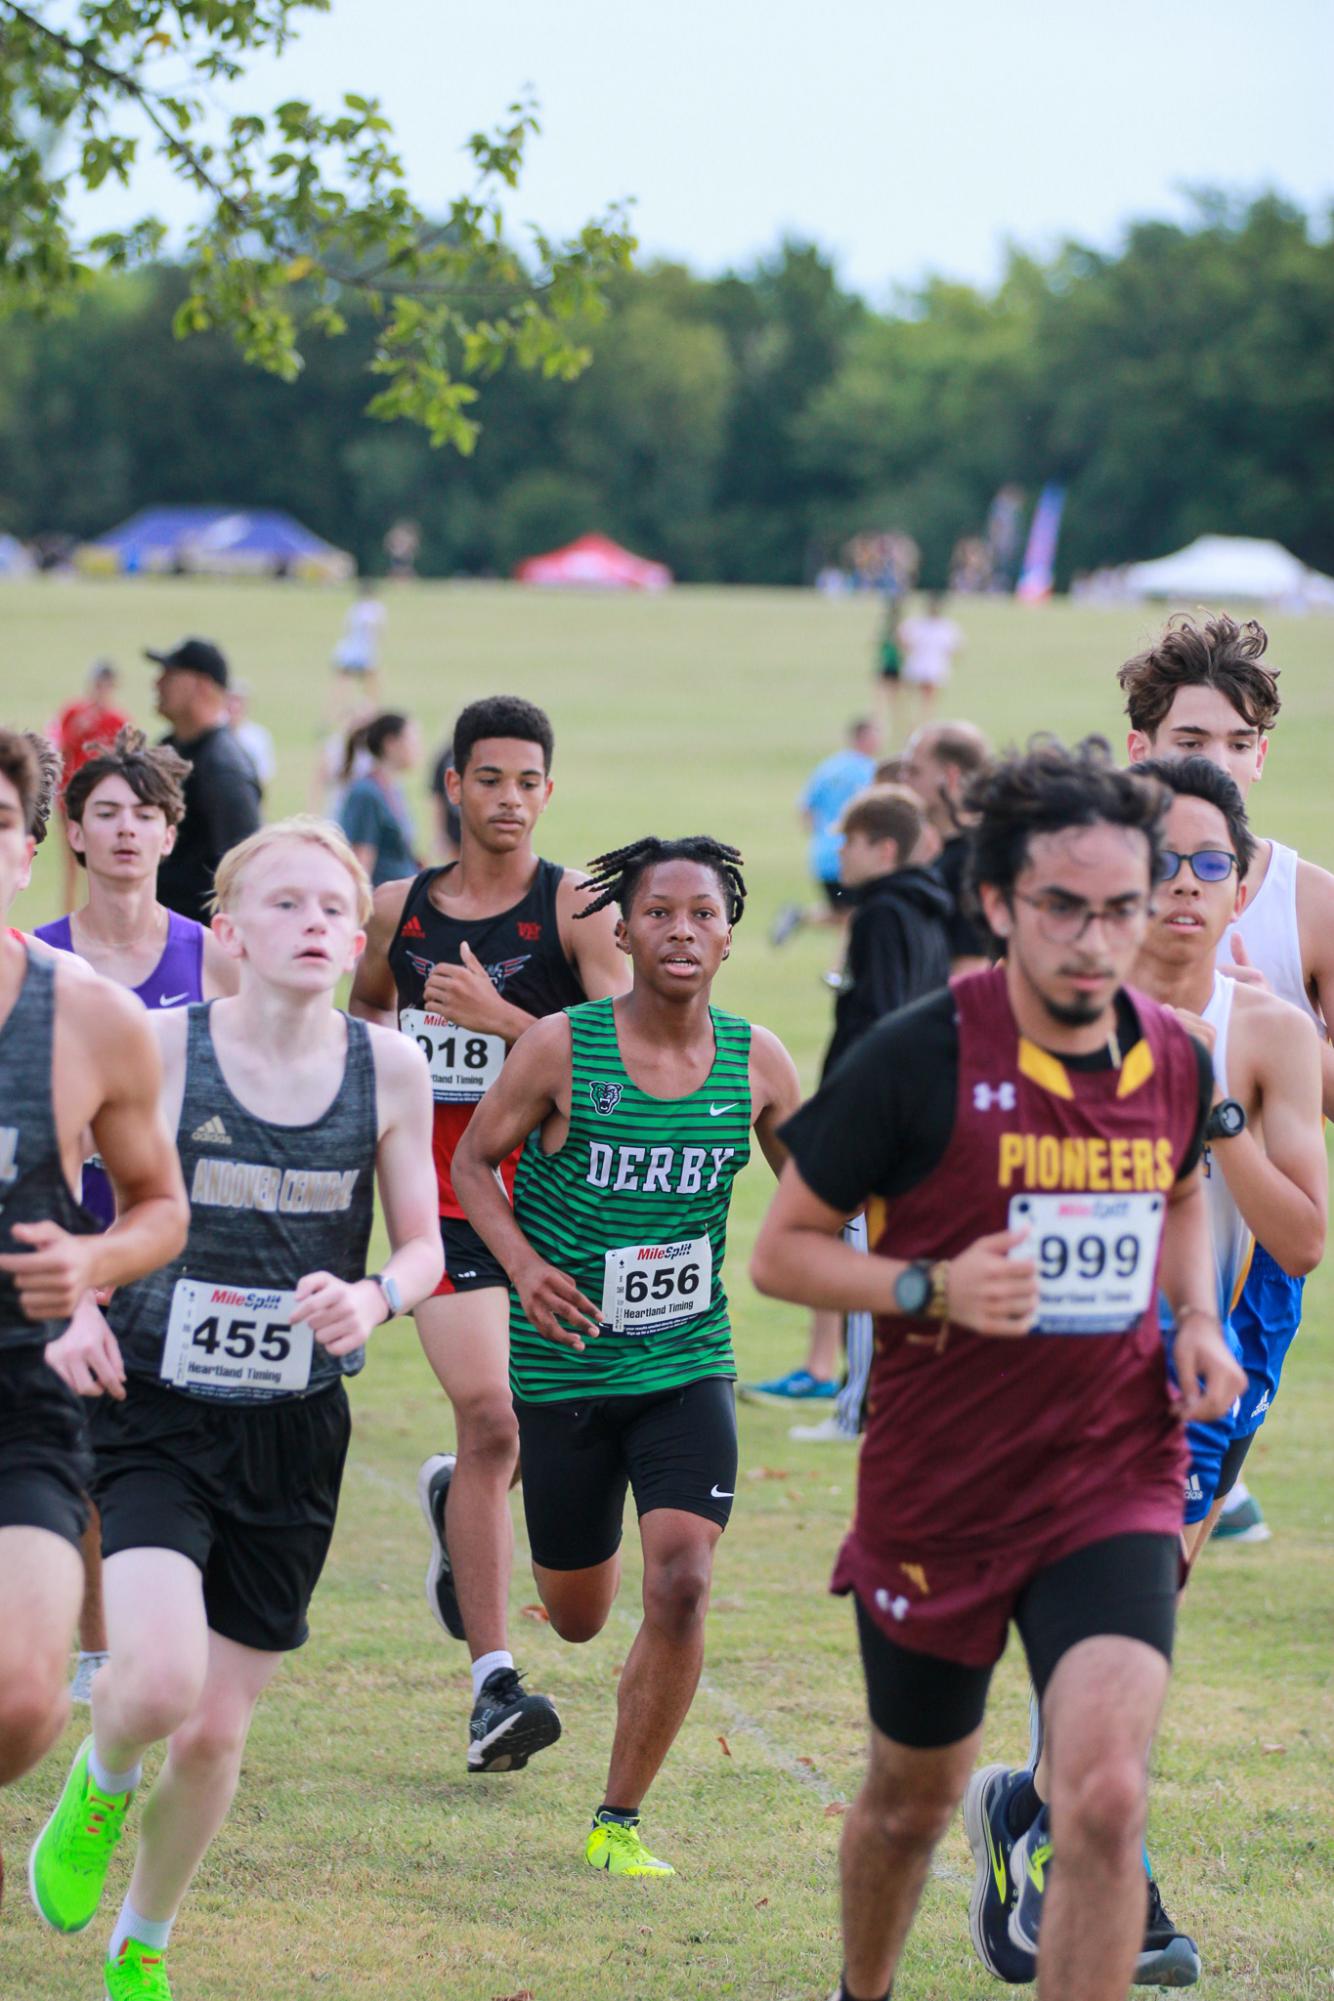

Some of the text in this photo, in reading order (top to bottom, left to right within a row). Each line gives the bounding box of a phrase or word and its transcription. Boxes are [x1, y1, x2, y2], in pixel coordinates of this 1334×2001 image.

[191, 1132, 232, 1145] adidas
[586, 1141, 735, 1194] DERBY
[998, 1133, 1175, 1191] PIONEERS
[637, 1243, 692, 1260] MileSplit
[1039, 1233, 1141, 1280] 999
[625, 1263, 700, 1303] 656
[210, 1289, 282, 1311] MileSplit
[623, 1300, 694, 1319] Heartland Timing
[192, 1316, 292, 1361] 455
[187, 1361, 243, 1378] Heartland
[248, 1368, 282, 1383] Timing
